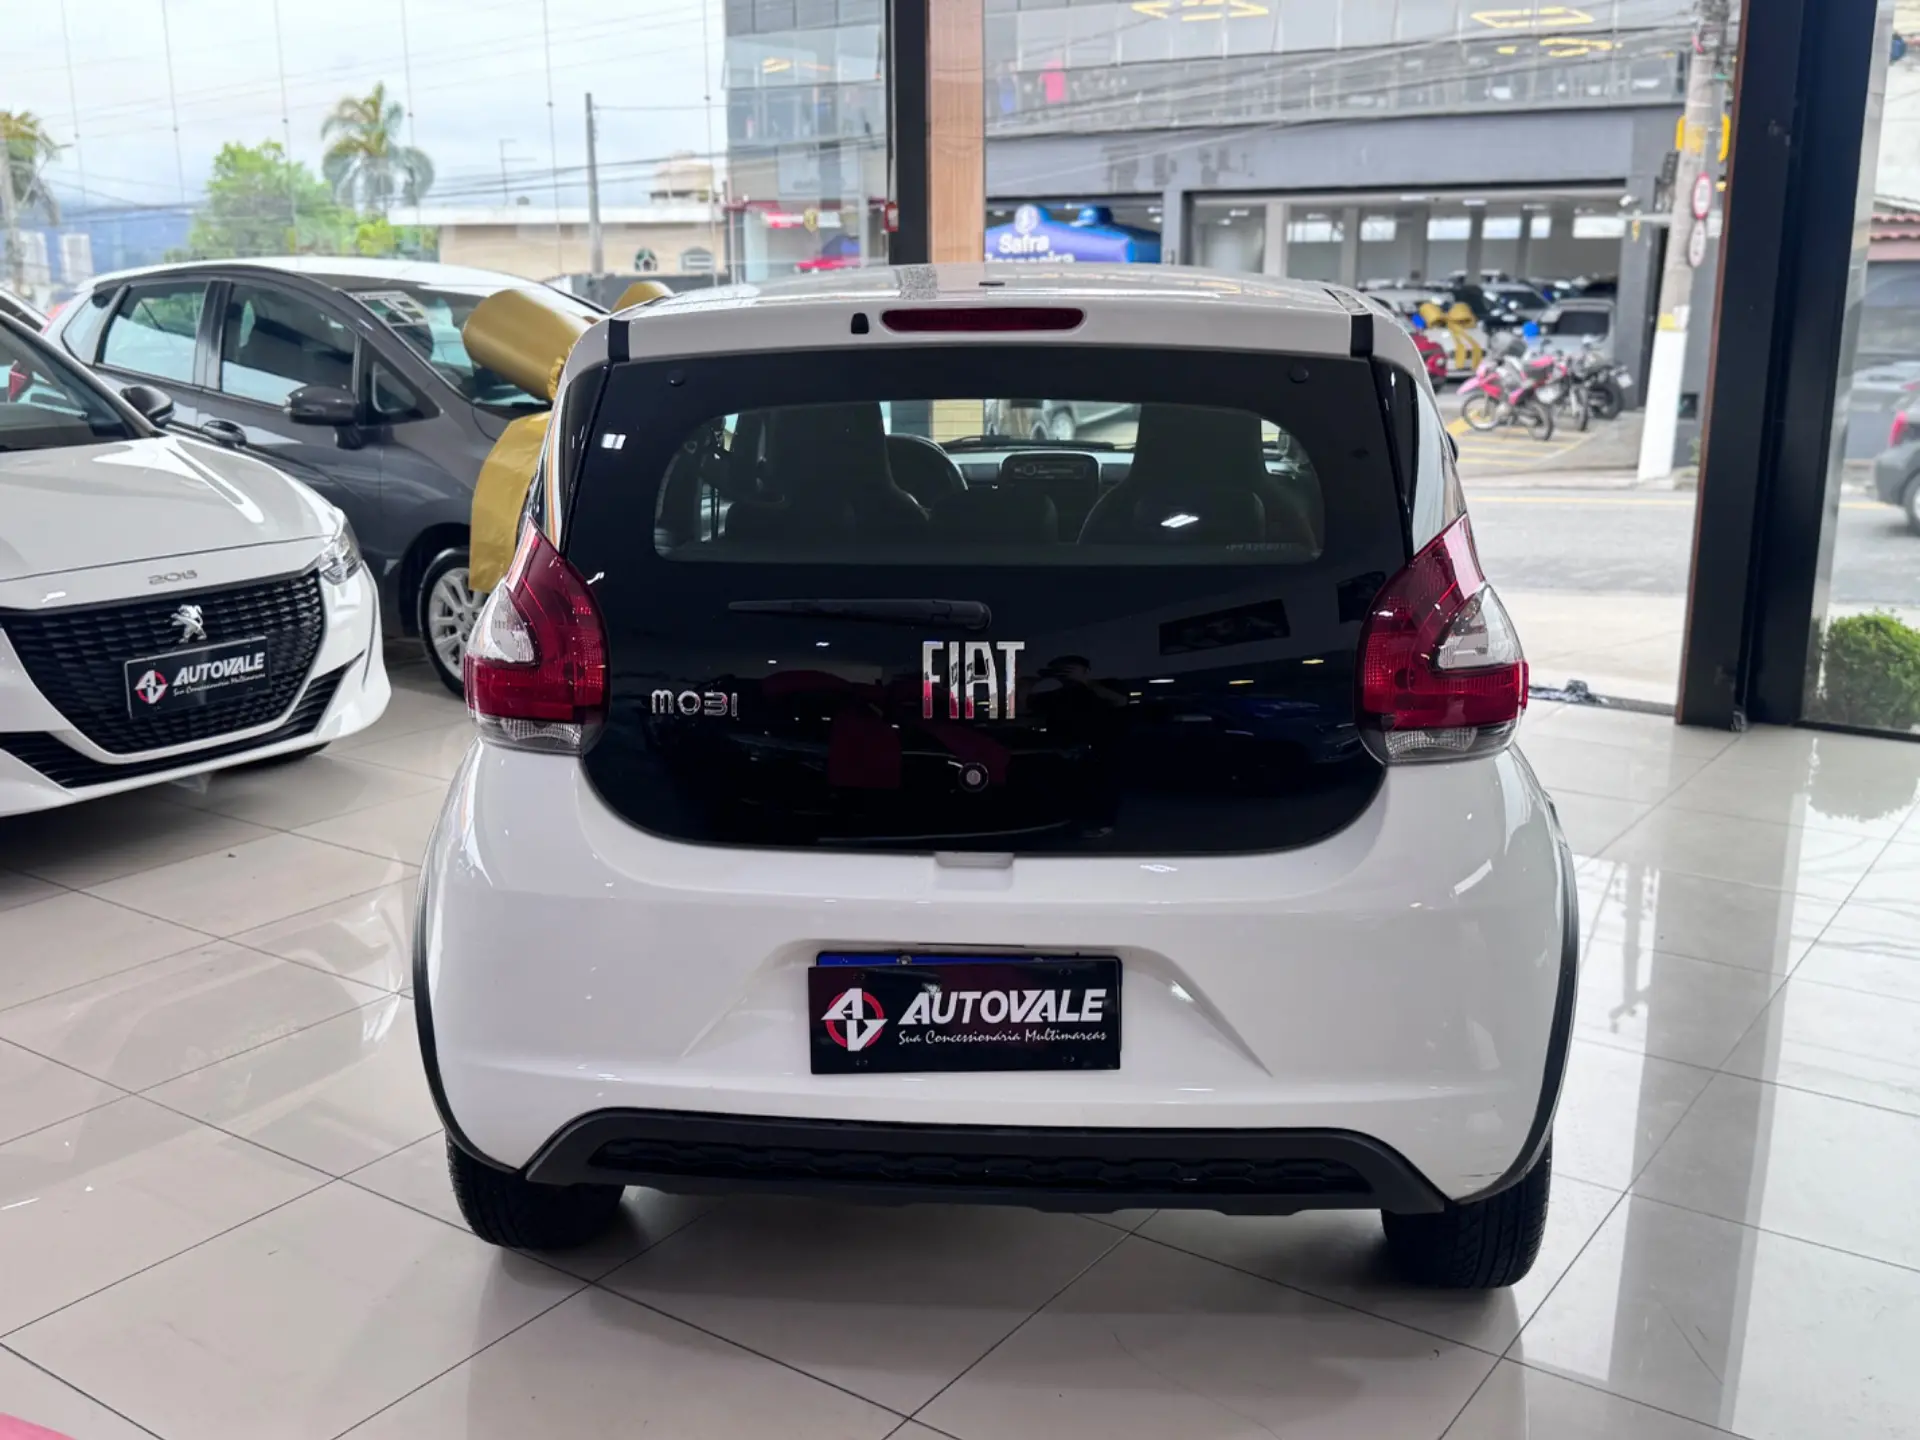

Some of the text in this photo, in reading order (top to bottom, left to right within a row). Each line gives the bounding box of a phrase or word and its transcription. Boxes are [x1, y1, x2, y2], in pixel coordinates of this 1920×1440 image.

[999, 233, 1049, 254] Safra
[172, 652, 265, 686] AUTOVALE
[923, 641, 1025, 719] FIAT
[651, 689, 738, 717] MOBI
[898, 989, 1107, 1025] AUTOVALE
[898, 1029, 921, 1045] Sua
[1025, 1027, 1107, 1043] Multimarcas
